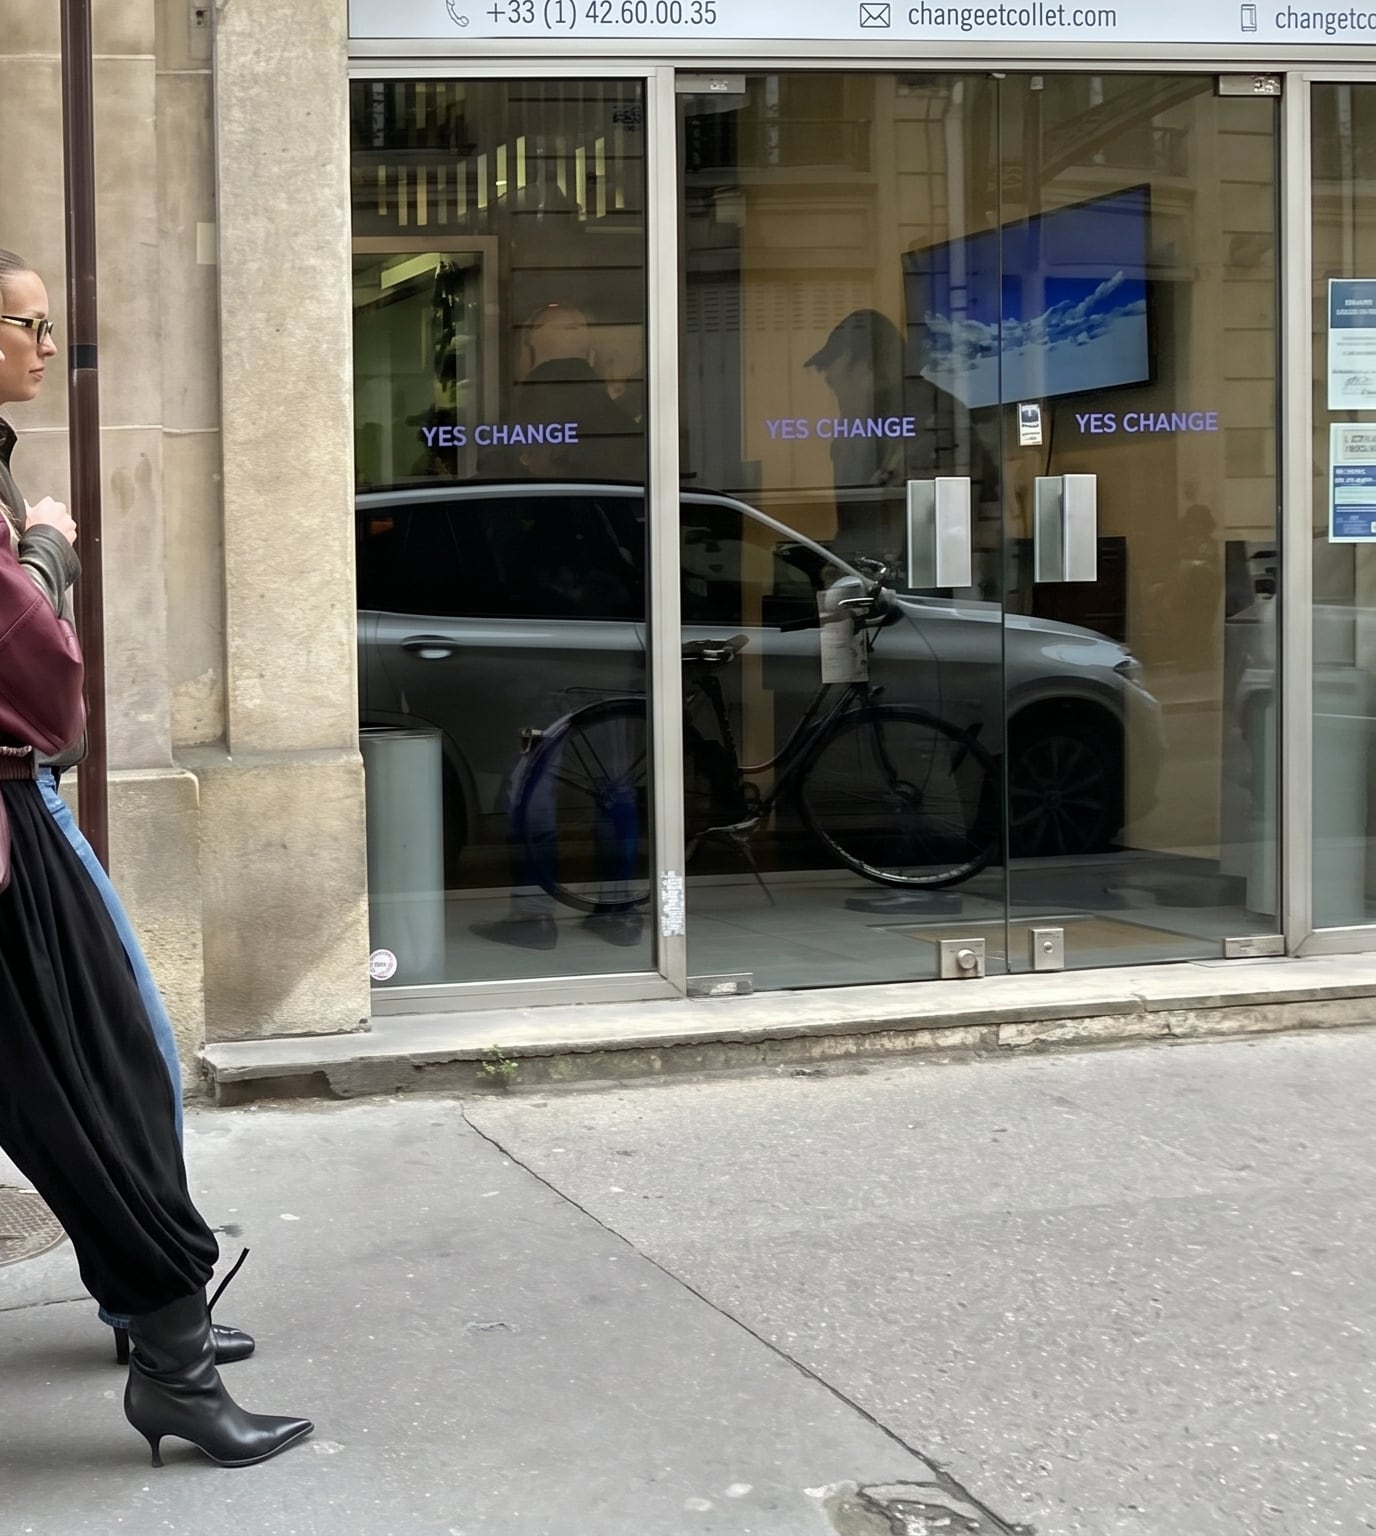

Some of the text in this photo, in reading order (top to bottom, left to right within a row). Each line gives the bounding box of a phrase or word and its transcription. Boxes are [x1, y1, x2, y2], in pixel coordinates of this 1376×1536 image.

[486, 0, 717, 30] +33 (1) 42.60.00.35
[908, 1, 1117, 32] changeetcollet.com
[765, 416, 916, 440] YES CHANGE
[1075, 411, 1218, 433] YES CHANGE
[422, 423, 579, 447] YES CHANGE
